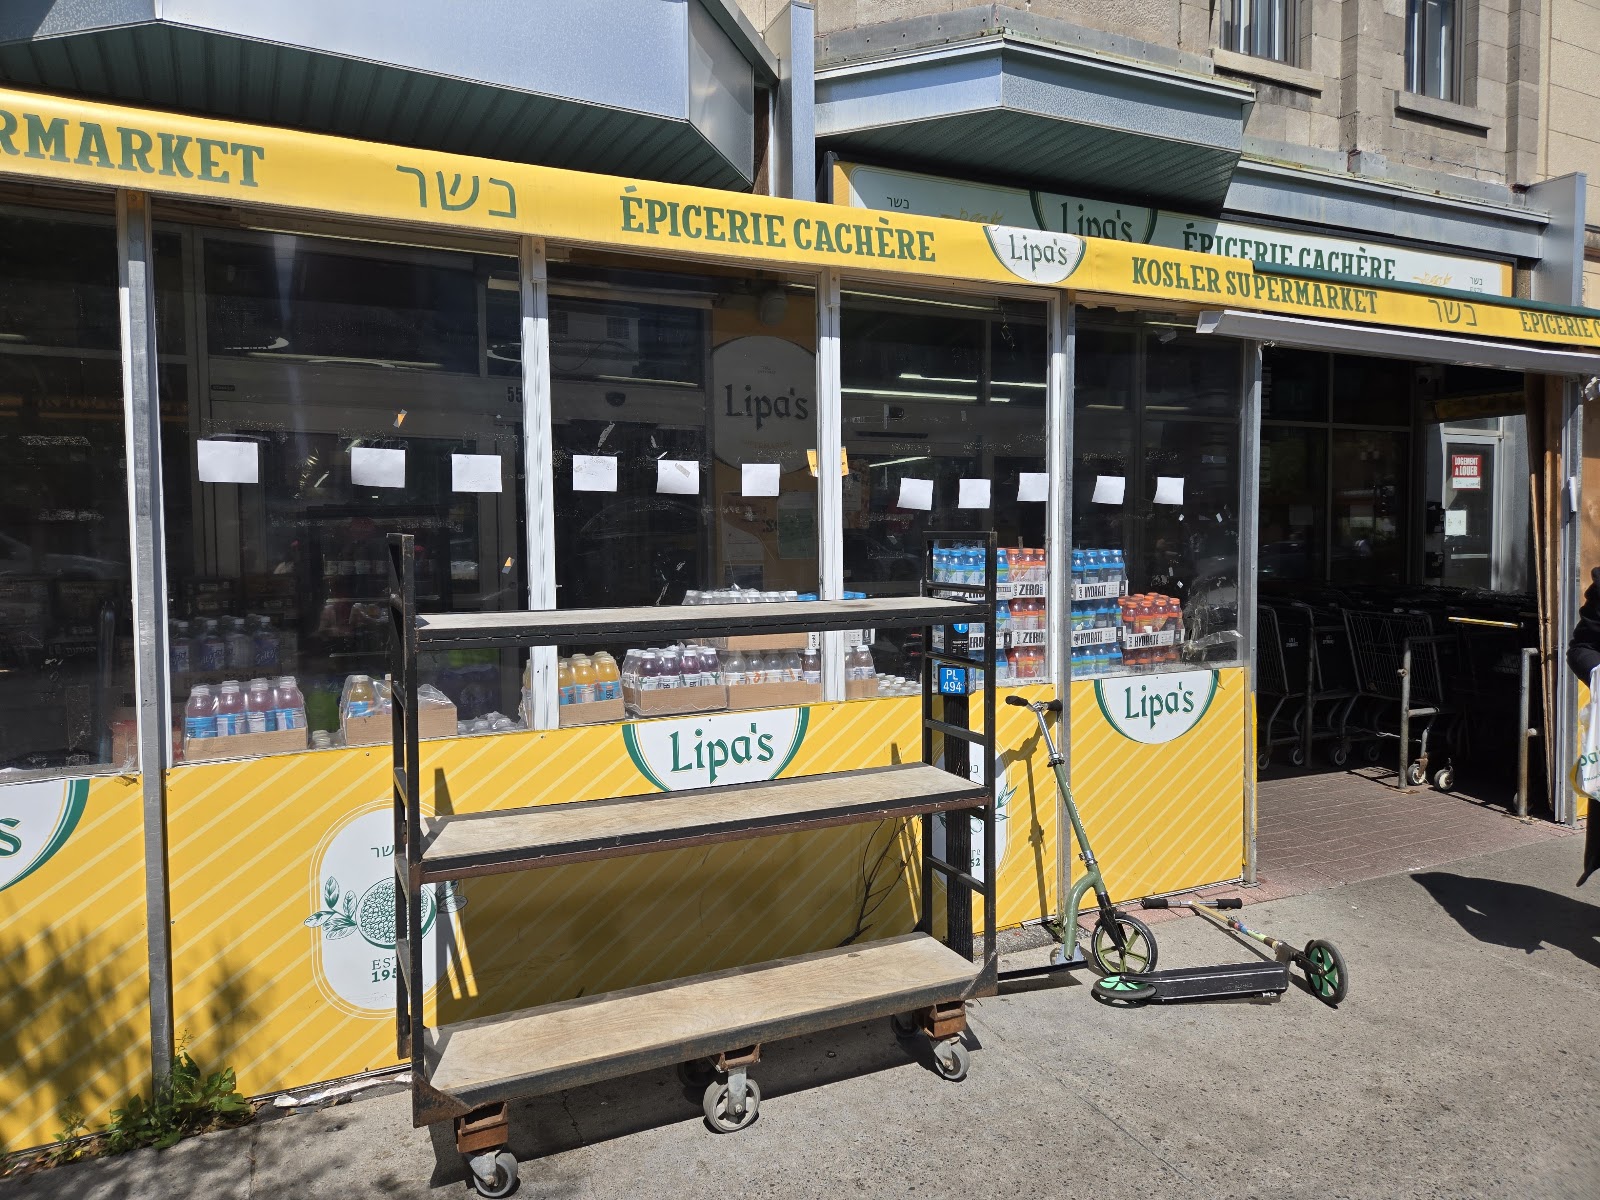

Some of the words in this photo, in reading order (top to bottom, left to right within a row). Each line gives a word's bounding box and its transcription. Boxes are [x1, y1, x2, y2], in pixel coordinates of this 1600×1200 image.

[396, 164, 516, 219] כשר
[887, 196, 910, 209] כשר
[620, 184, 787, 250] ÉPICERIE
[793, 216, 936, 262] CACHÈRE
[1008, 233, 1068, 272] Lipa's
[1183, 222, 1293, 267] ÉPICERIE
[1299, 246, 1396, 281] CACHÈRE
[1226, 270, 1378, 314] SUPERMARKET
[1428, 298, 1478, 327] כשר
[725, 383, 808, 430] Lipa's
[1454, 456, 1478, 466] LOGEMENT
[1459, 466, 1478, 476] LOUER
[1018, 583, 1039, 596] ZERO
[1084, 585, 1106, 598] HYDRATE
[969, 636, 984, 649] ERO
[1023, 631, 1044, 644] ZERO
[1134, 634, 1159, 647] HYDRATE
[946, 669, 958, 680] PL
[943, 681, 962, 692] 494
[1124, 681, 1194, 730] Lipa's
[669, 722, 775, 784] Lipa's
[371, 845, 394, 858] שר
[371, 969, 397, 983] 195
